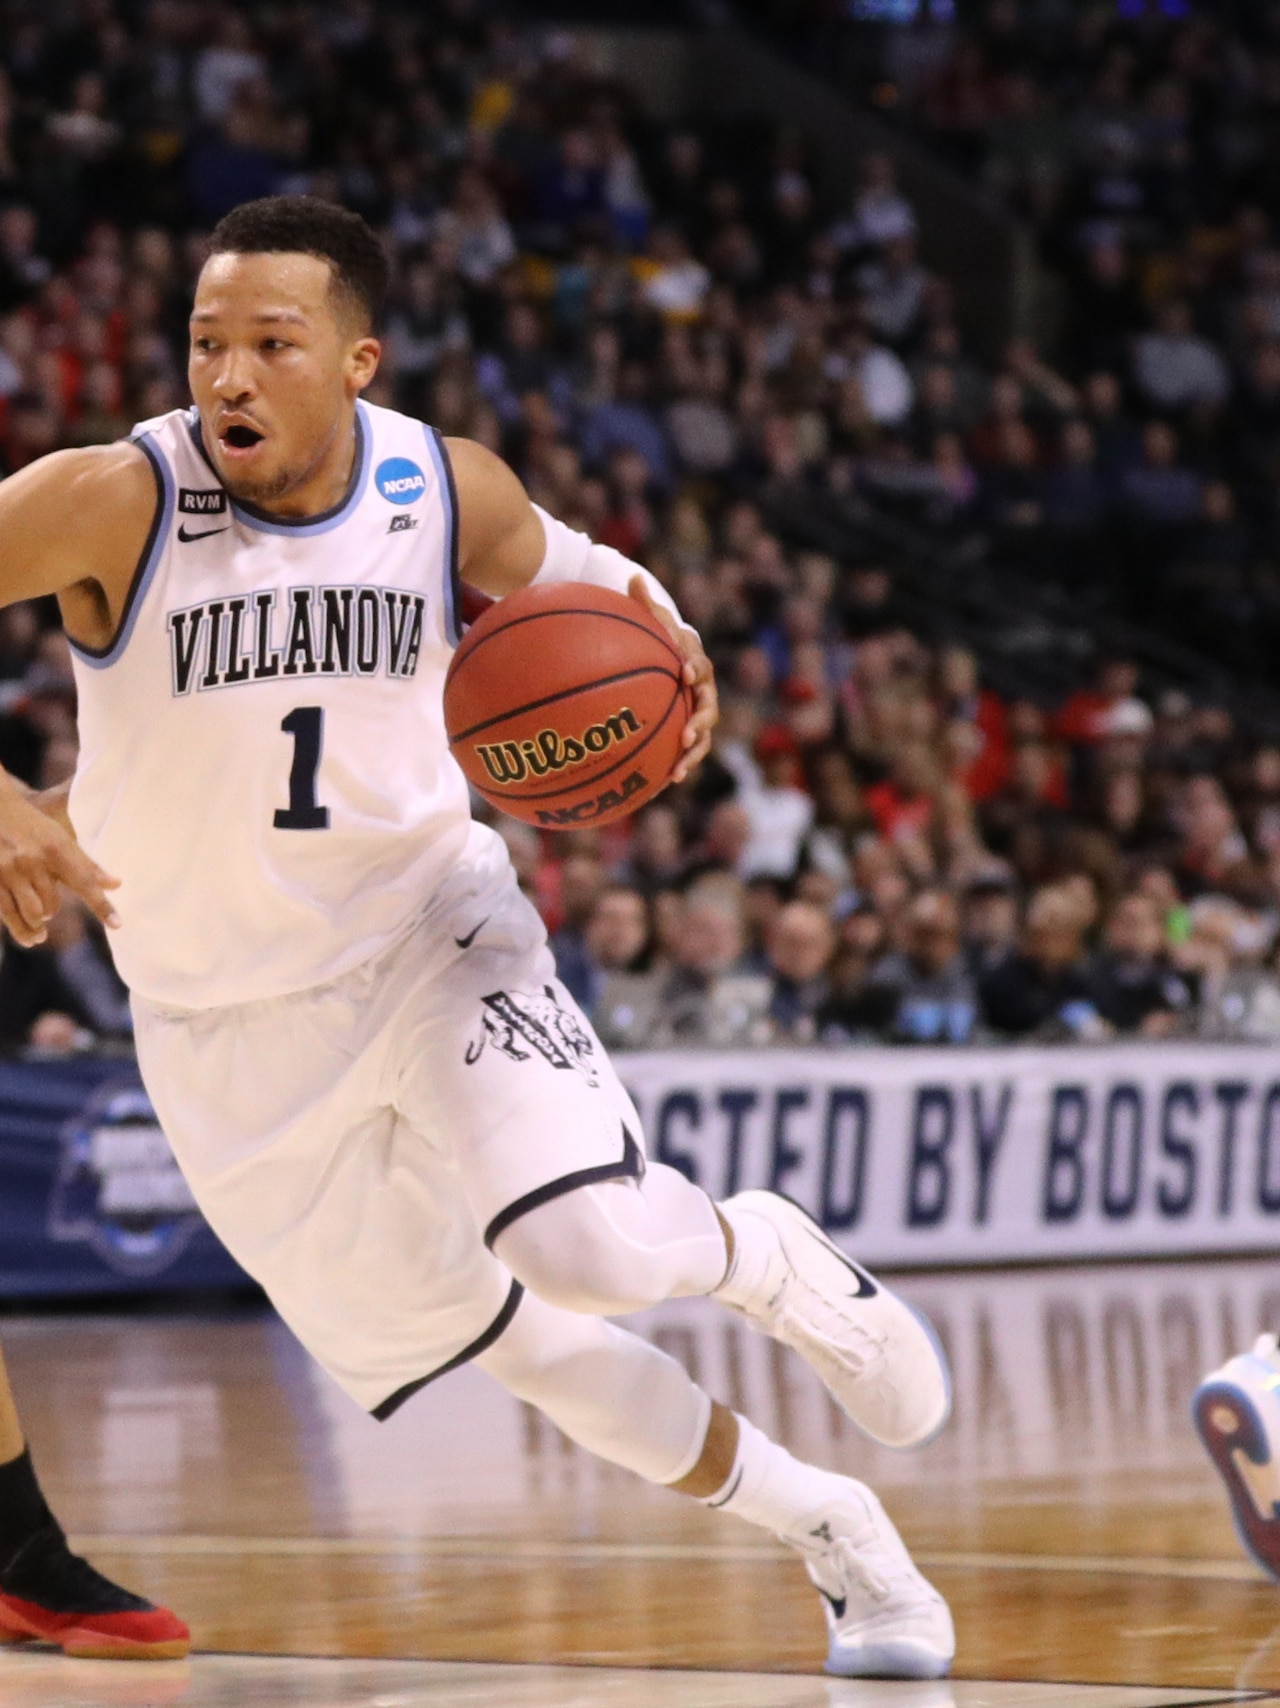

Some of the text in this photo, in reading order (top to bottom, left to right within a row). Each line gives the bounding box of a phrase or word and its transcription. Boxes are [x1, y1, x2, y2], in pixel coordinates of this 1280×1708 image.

[183, 493, 221, 510] RVM
[383, 475, 425, 495] NCAA
[167, 584, 427, 698] VILLANOVA
[273, 706, 331, 830] 1
[475, 706, 643, 785] Wilson
[534, 770, 649, 825] NCAA
[632, 1084, 872, 1231] STED
[904, 1078, 1016, 1229] BY
